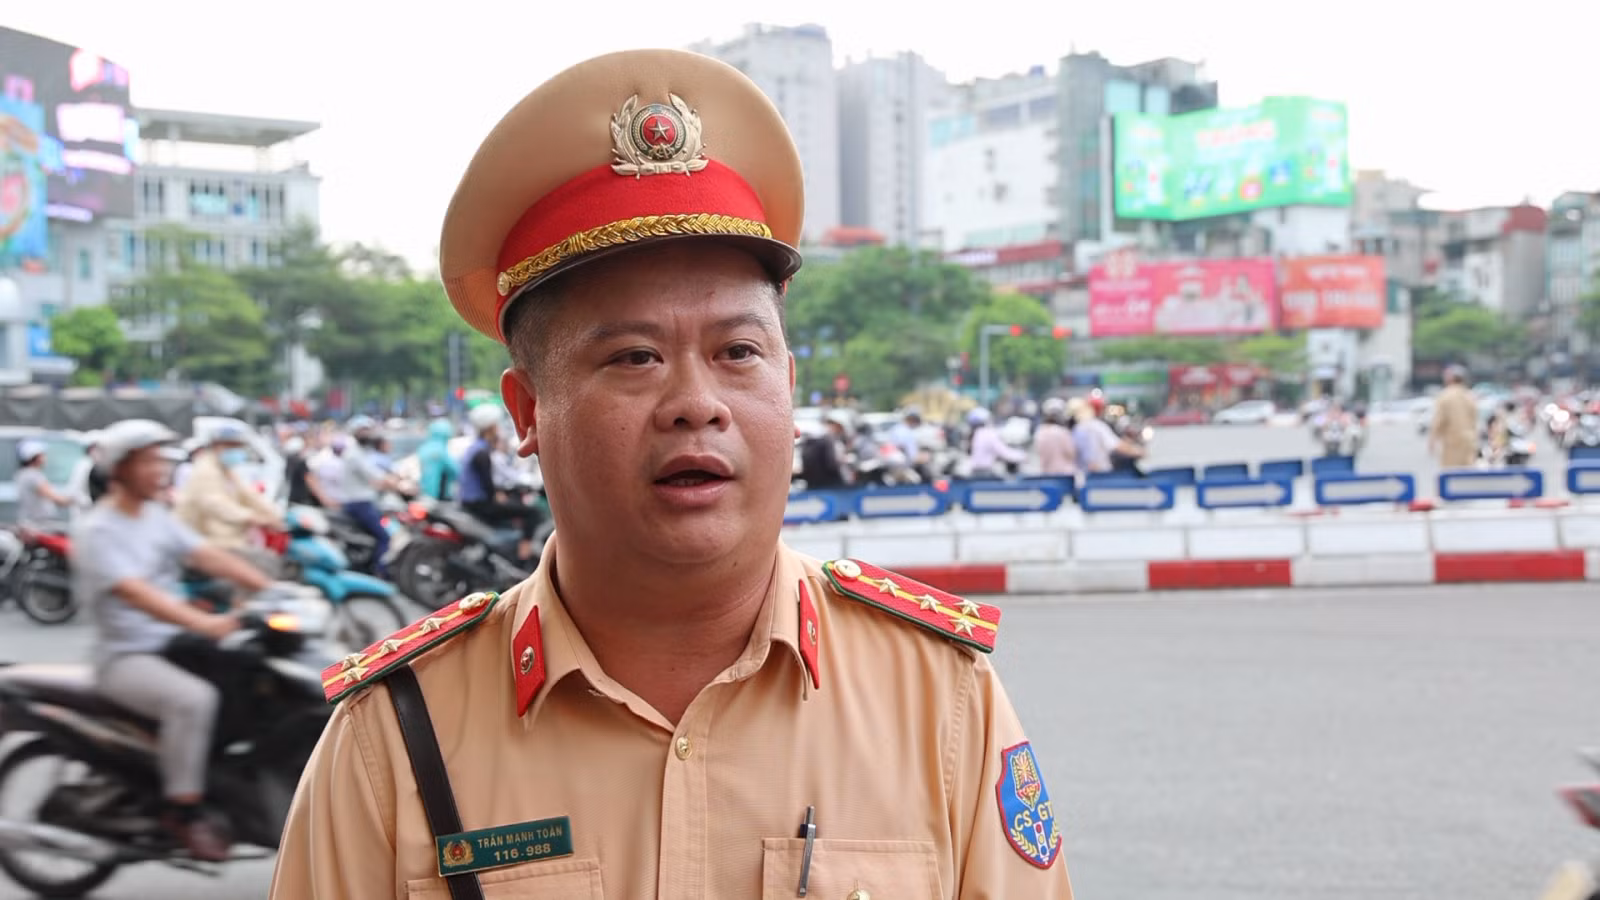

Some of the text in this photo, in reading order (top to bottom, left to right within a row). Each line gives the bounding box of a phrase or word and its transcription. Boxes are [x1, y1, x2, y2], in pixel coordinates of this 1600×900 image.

[1014, 800, 1053, 831] CS GT
[494, 843, 552, 861] 116.988
